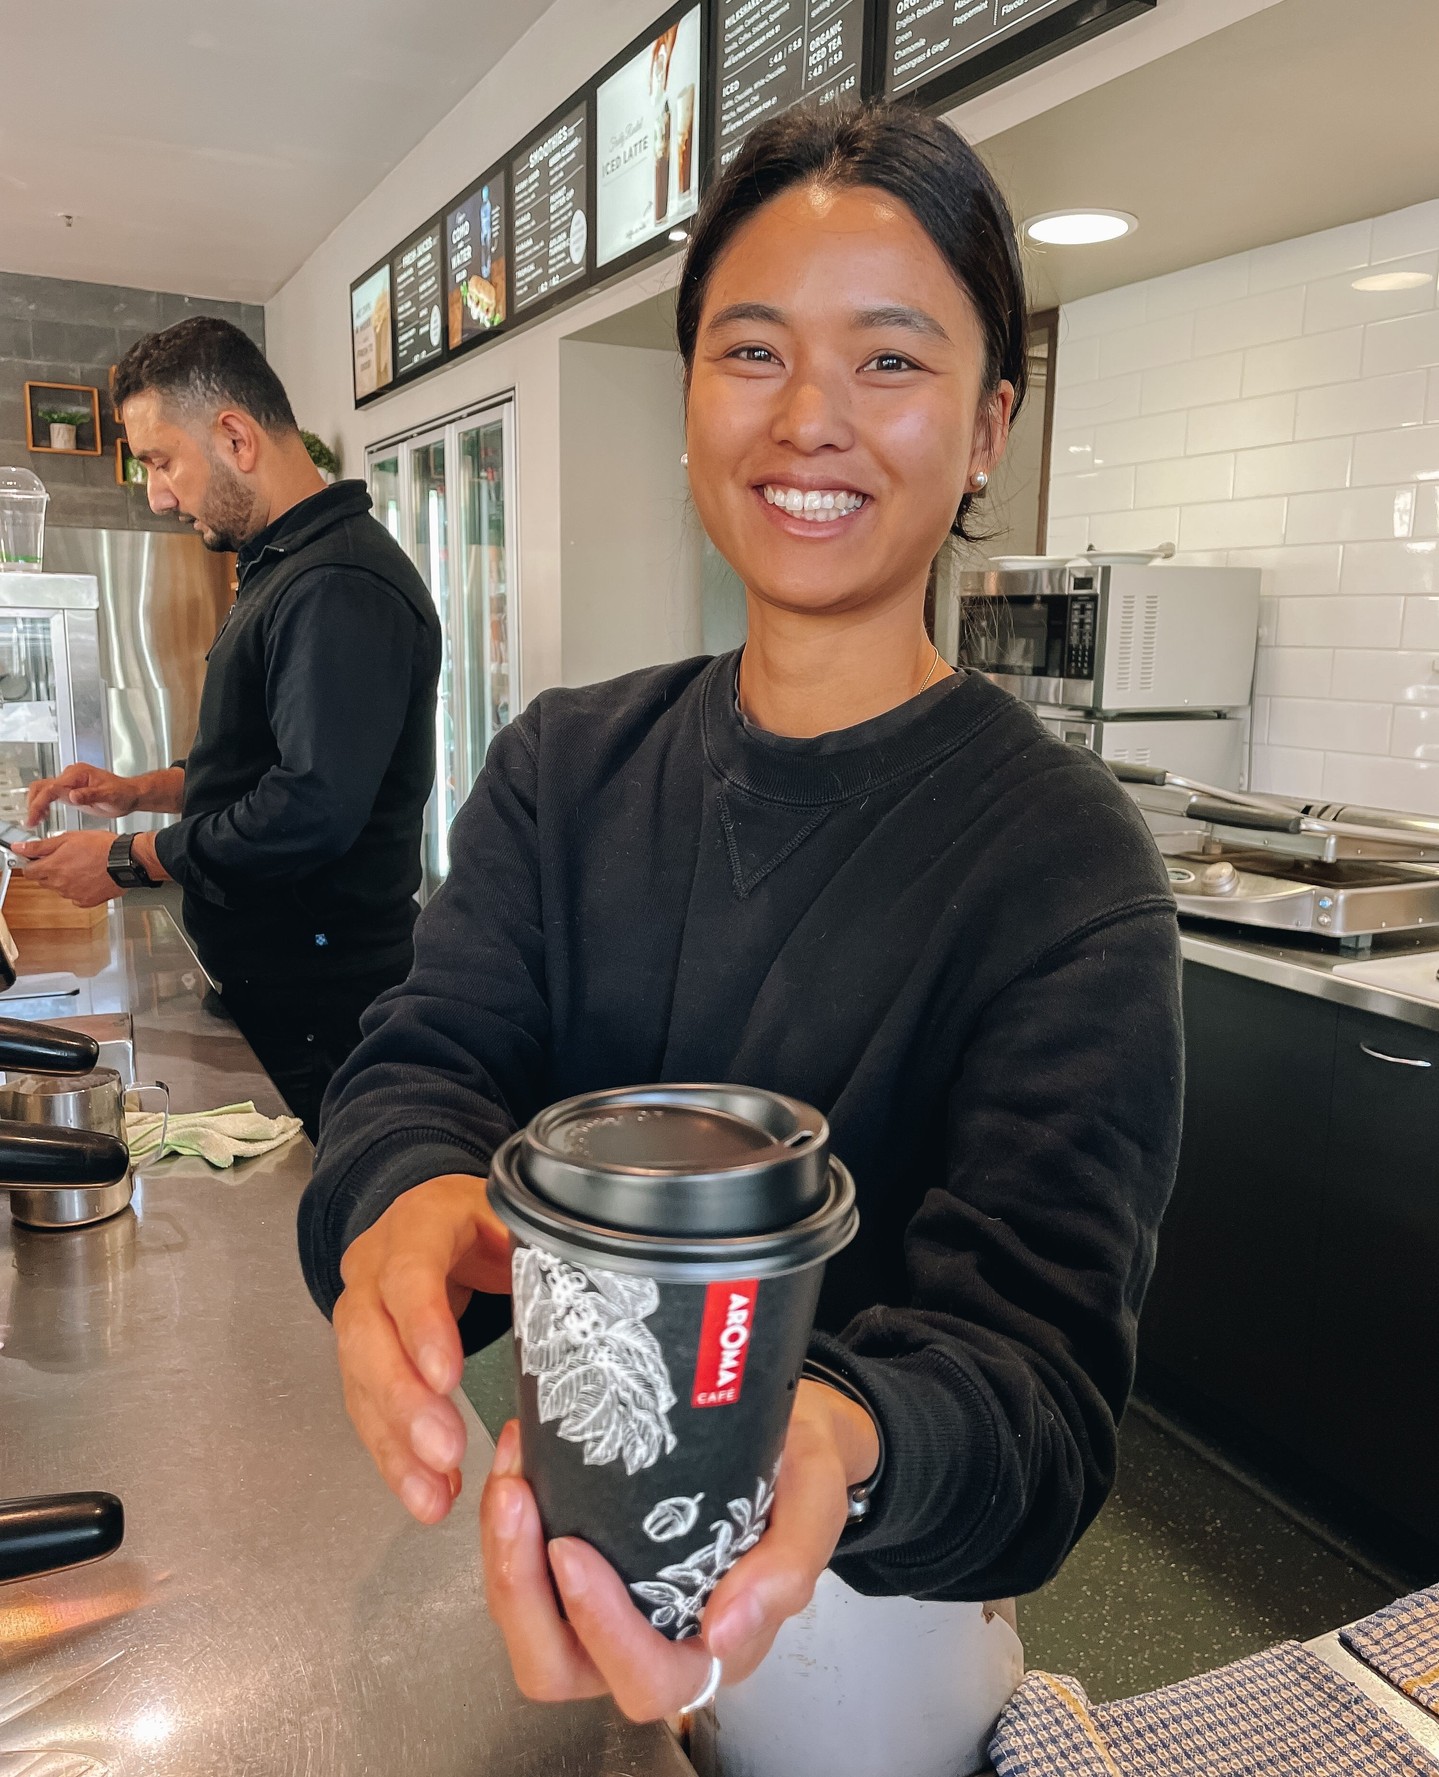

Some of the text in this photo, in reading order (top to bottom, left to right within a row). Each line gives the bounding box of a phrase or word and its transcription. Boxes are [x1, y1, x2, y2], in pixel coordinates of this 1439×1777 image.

[895, 12, 916, 31] English
[952, 0, 988, 27] Peppermint
[808, 35, 843, 67] ICED TEA
[809, 19, 843, 52] ORGANIC
[894, 30, 913, 45] Green
[894, 38, 927, 61] Chamomile
[893, 52, 927, 76] Lemongrass
[931, 38, 951, 55] Ginger
[722, 80, 740, 98] ICED
[529, 125, 568, 169] SMOOTHIES
[602, 155, 622, 178] ICED
[623, 135, 649, 165] LATTE
[716, 1292, 750, 1388] AROMA
